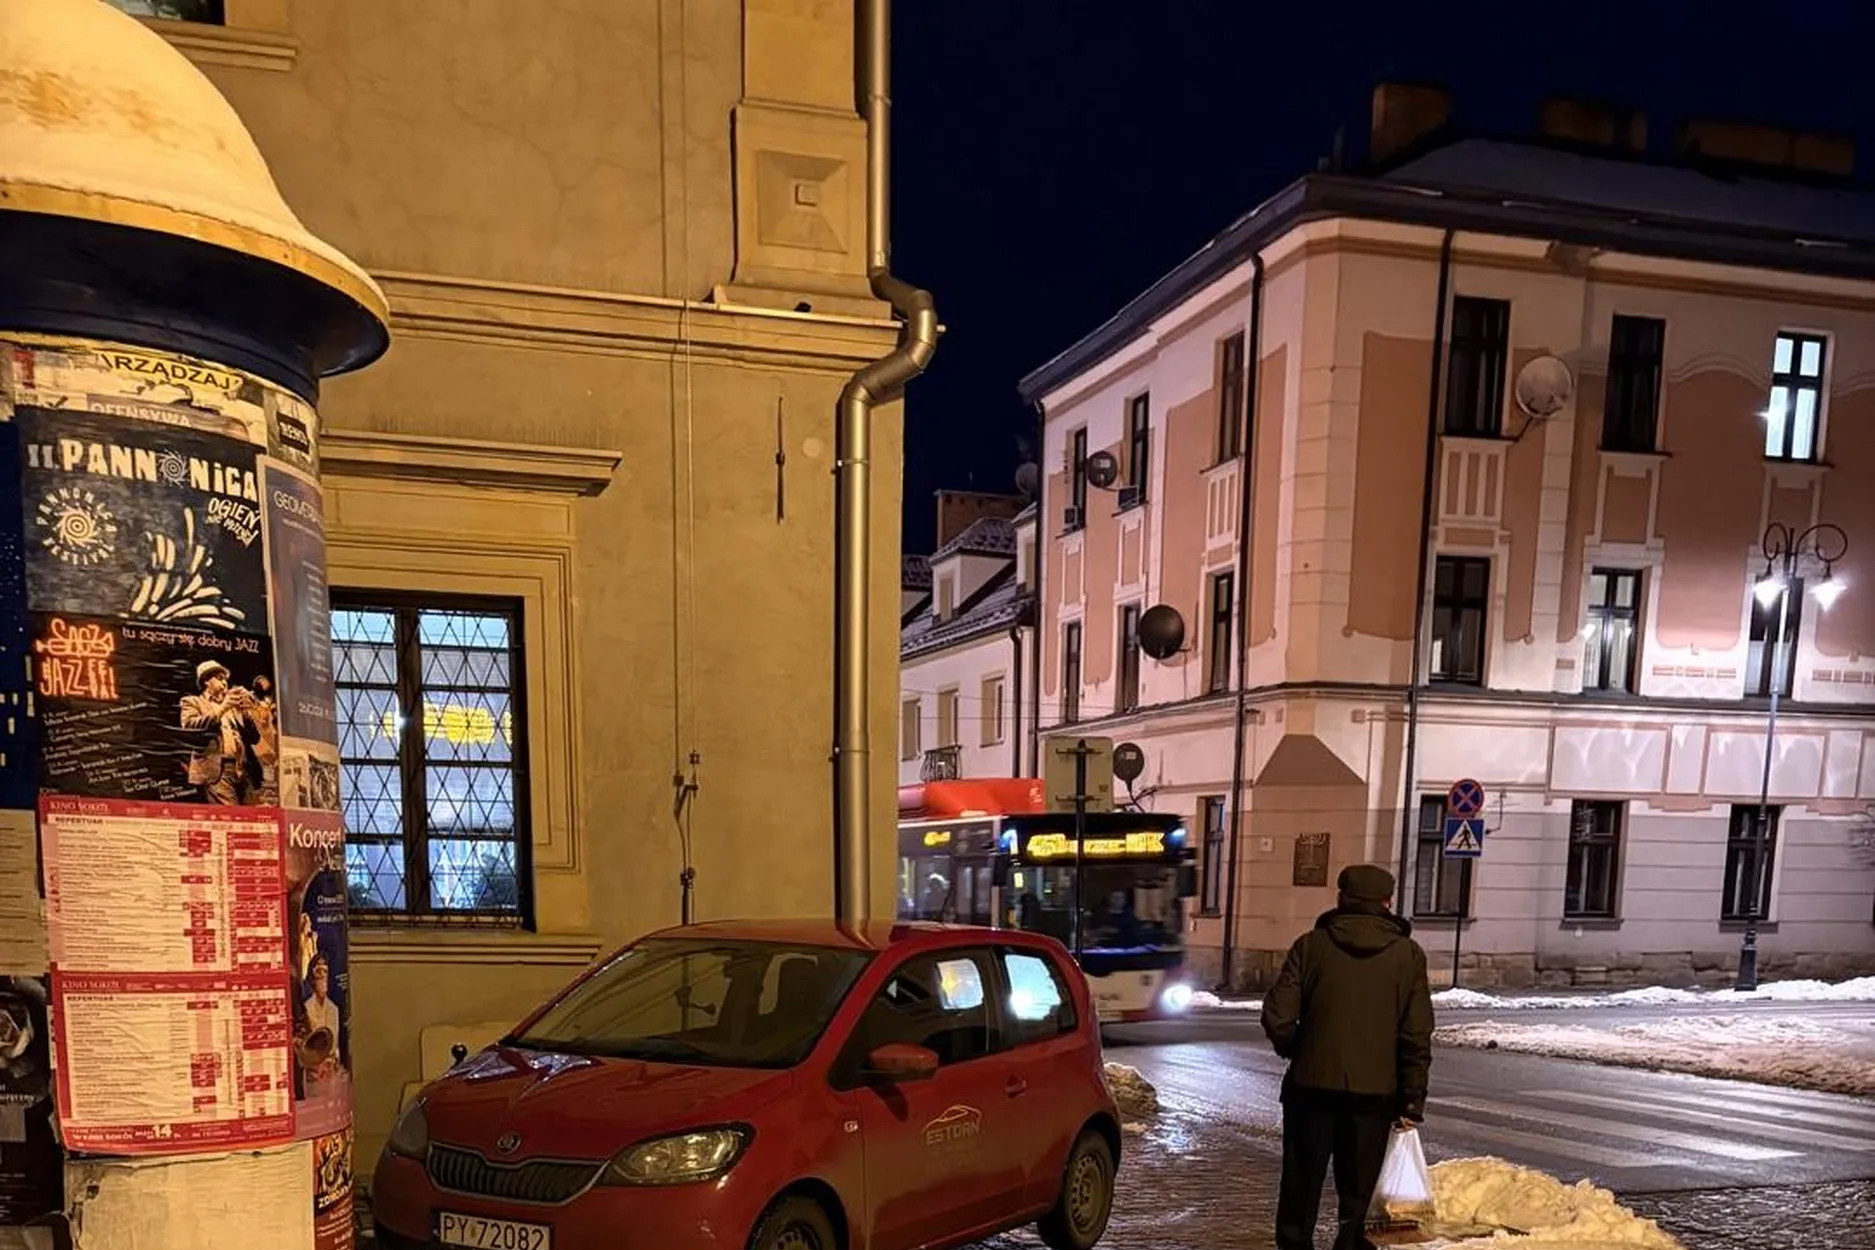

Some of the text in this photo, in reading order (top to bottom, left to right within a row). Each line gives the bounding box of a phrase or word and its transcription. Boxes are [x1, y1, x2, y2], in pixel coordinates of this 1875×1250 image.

[198, 633, 232, 652] dobry
[235, 636, 260, 654] JAZZ
[40, 656, 89, 696] JAZZ
[152, 1124, 172, 1139] 14
[444, 1215, 468, 1243] PY
